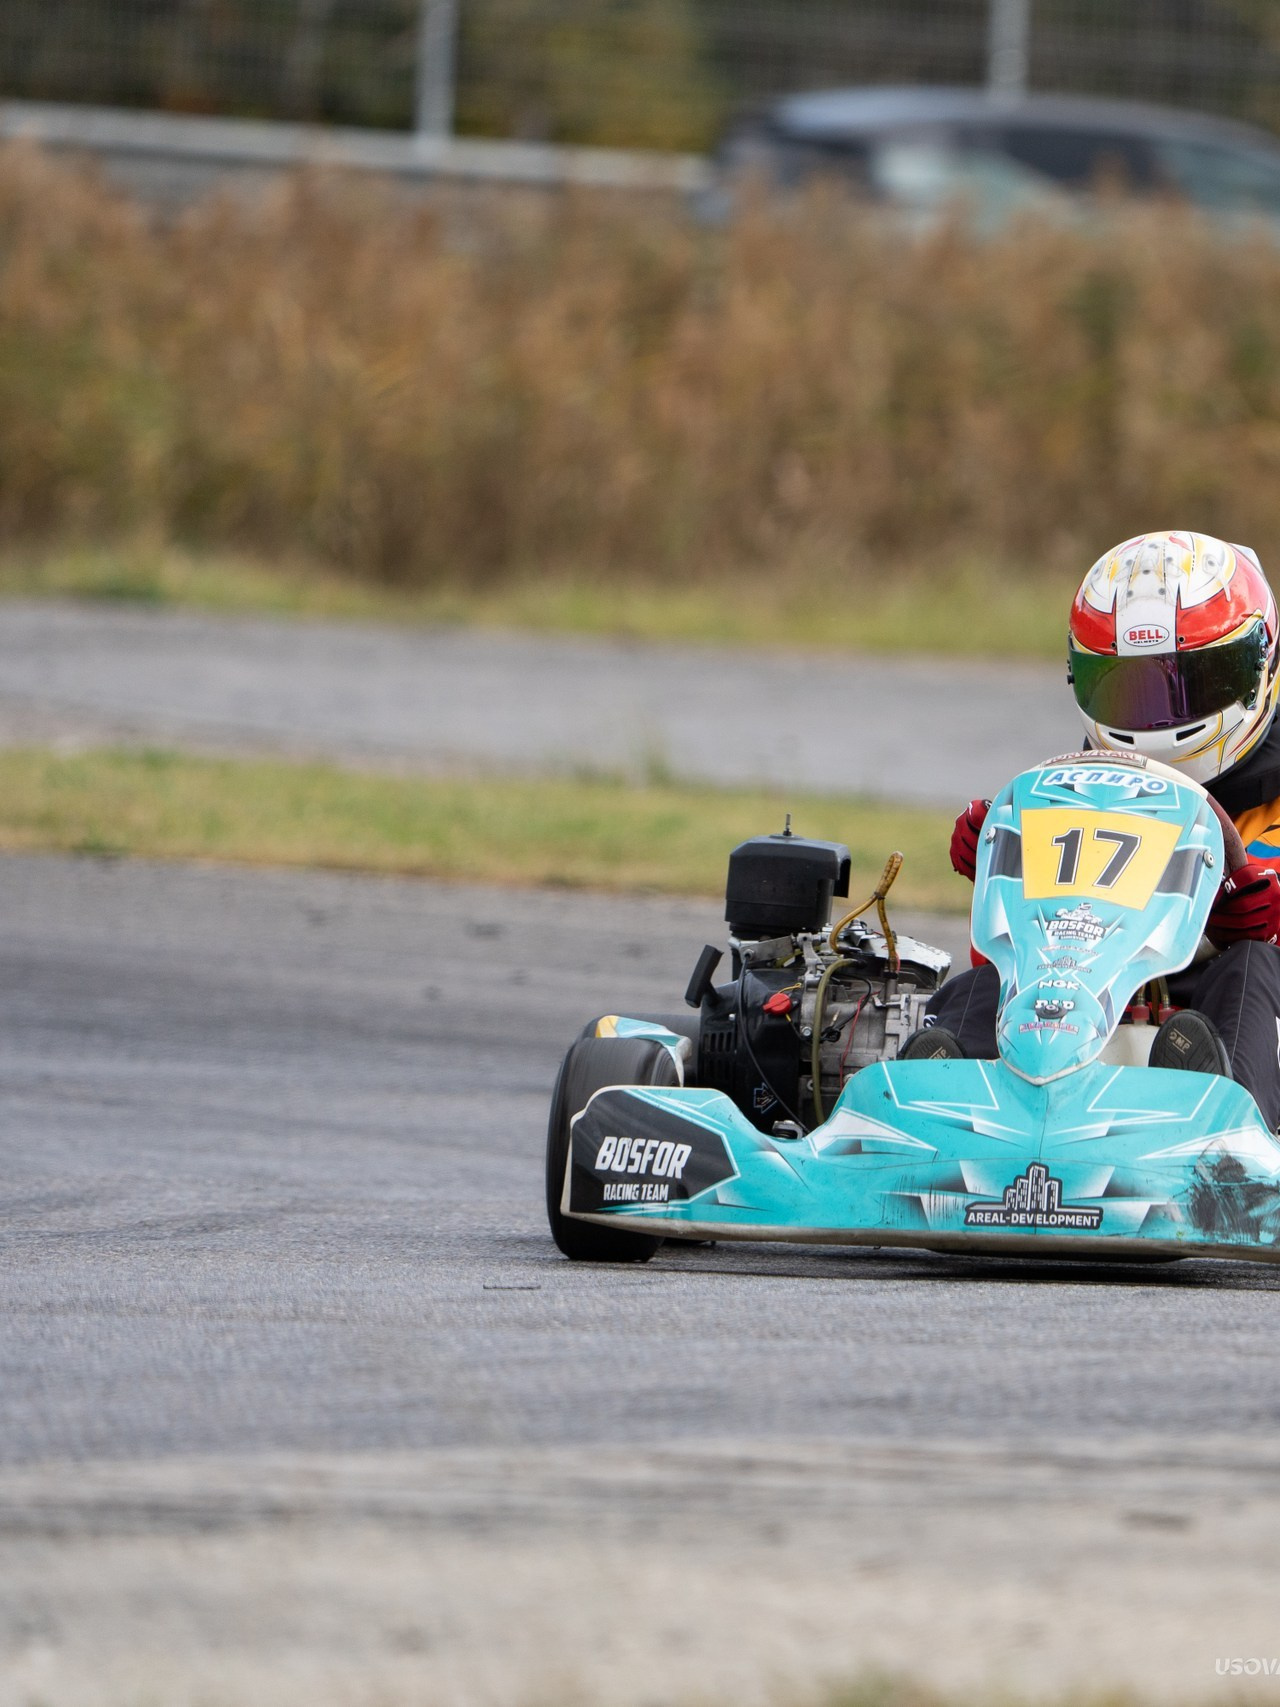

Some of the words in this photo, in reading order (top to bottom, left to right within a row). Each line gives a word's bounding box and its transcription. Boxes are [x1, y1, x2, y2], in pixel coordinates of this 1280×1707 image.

[1129, 630, 1163, 640] BELL
[1044, 771, 1166, 793] АСПИРО
[1051, 828, 1142, 889] 17
[1048, 920, 1104, 937] BOSFOR
[1038, 979, 1080, 990] NGK
[1169, 1031, 1190, 1049] OMP
[594, 1136, 692, 1180] BOSFOR
[603, 1183, 640, 1201] RACING
[641, 1183, 669, 1201] TEAM
[967, 1211, 1099, 1227] AREAL-DEVELOPMENT
